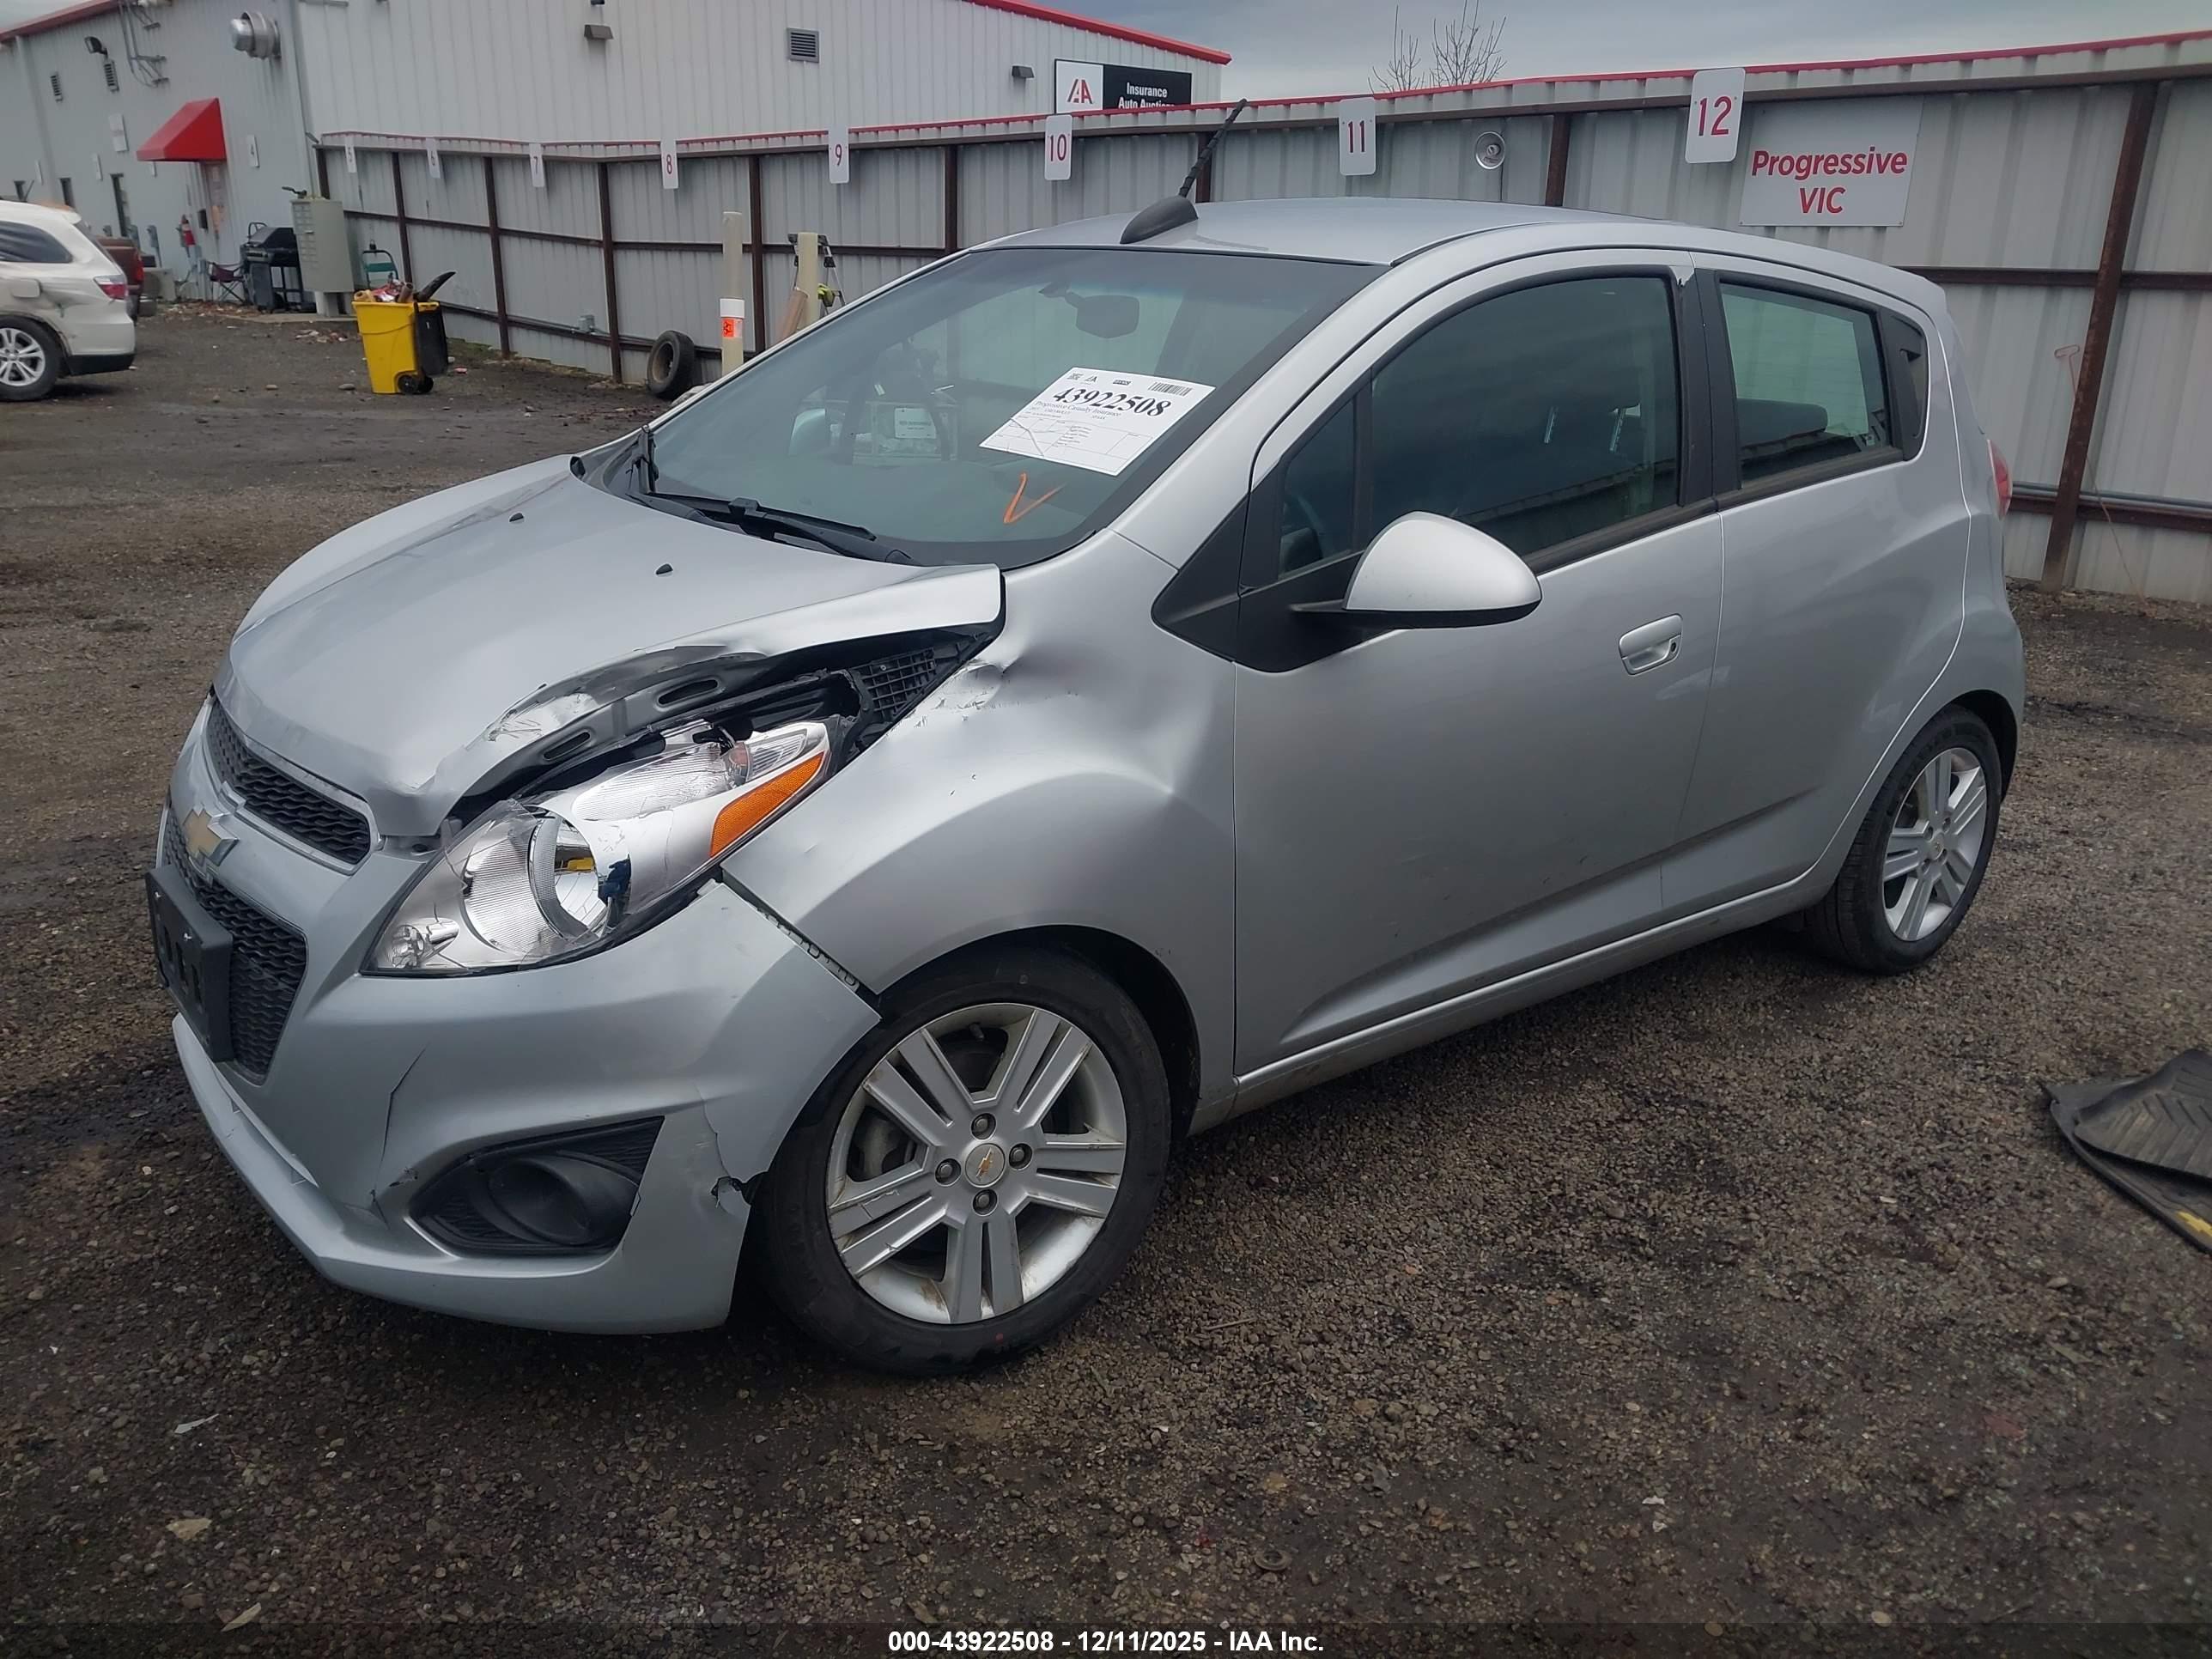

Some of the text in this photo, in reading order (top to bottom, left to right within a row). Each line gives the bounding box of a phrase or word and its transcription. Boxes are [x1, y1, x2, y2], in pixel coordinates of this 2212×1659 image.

[1118, 96, 1175, 109] Auto Aucti
[1127, 82, 1168, 98] Insurance
[1698, 95, 1732, 137] 12
[1050, 134, 1067, 161] 10
[1347, 120, 1365, 153] 11
[665, 154, 673, 175] 8
[835, 143, 842, 166] 9
[1752, 146, 1908, 180] Progressive
[1799, 186, 1846, 214] VIC
[1053, 386, 1171, 417] 43922508
